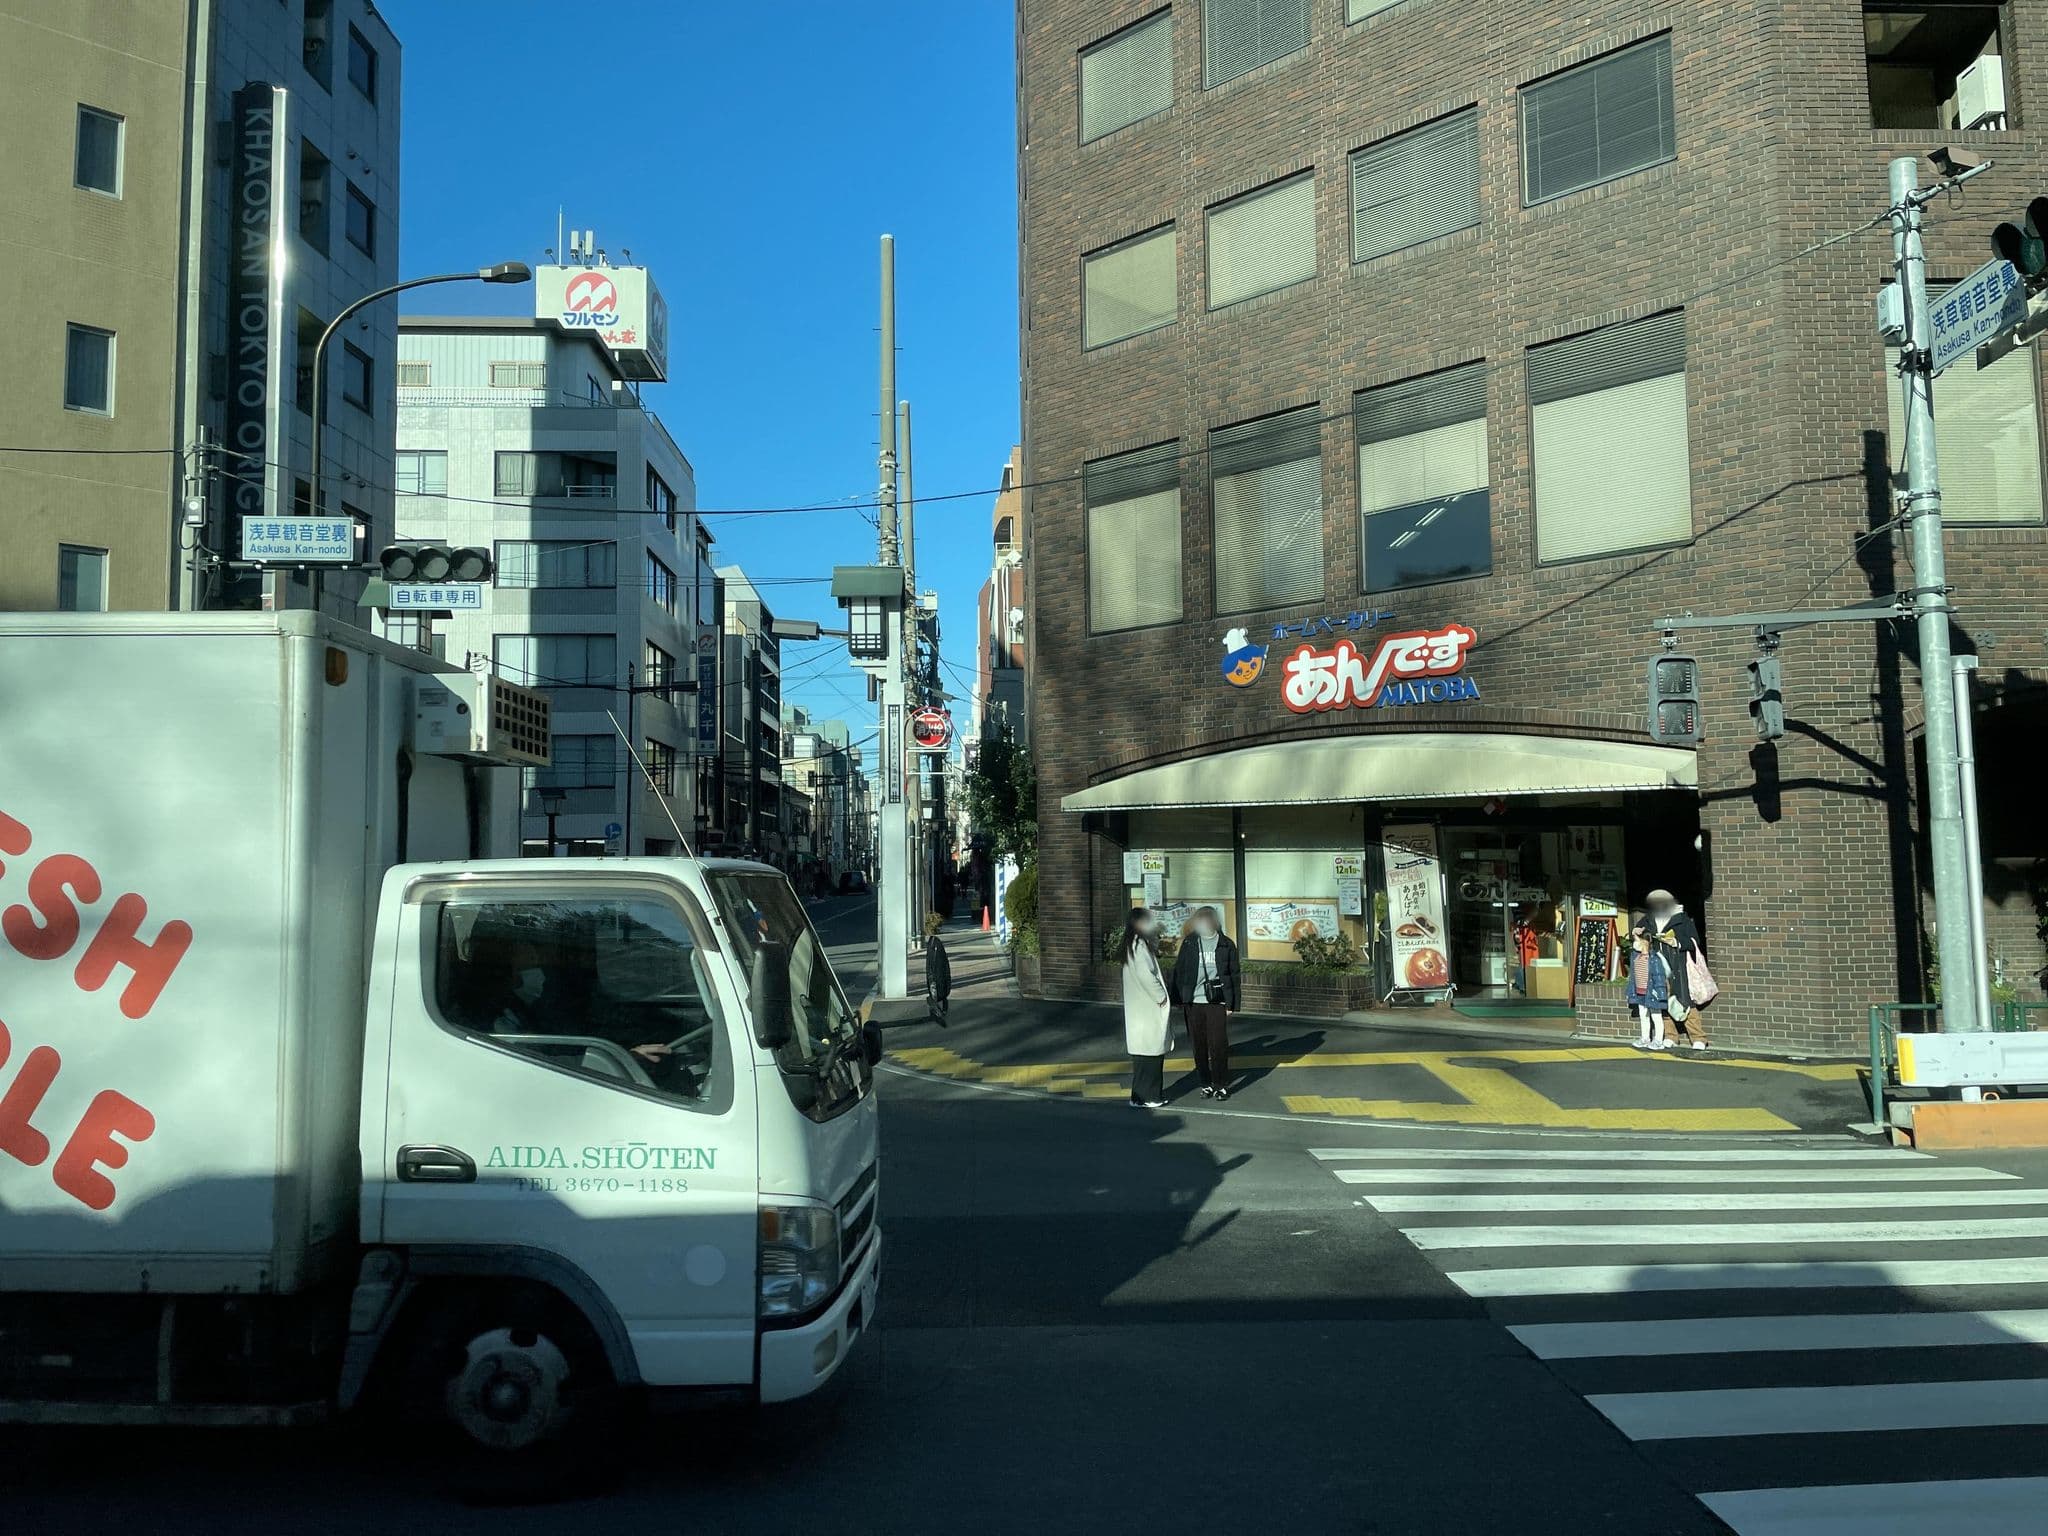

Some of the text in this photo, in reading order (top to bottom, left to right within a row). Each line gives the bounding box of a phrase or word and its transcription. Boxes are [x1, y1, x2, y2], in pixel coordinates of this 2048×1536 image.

[243, 107, 272, 277] KHAOSAN
[1932, 262, 2017, 340] 浅草観音堂裏
[562, 312, 619, 326] マルセン
[1937, 297, 2021, 360] Asakusa Kan-nondo
[238, 288, 268, 408] TOKYO
[249, 523, 347, 542] 浅草観音堂裏
[250, 543, 347, 555] Asakusa Kan-nondo
[396, 590, 476, 604] 自転車専用
[1271, 609, 1397, 640] ホームベーカリー
[1284, 629, 1471, 707] あんです
[1377, 676, 1481, 709] MATOBA
[915, 722, 944, 736] 消火栓
[514, 1177, 689, 1193] TEL 3670-1188
